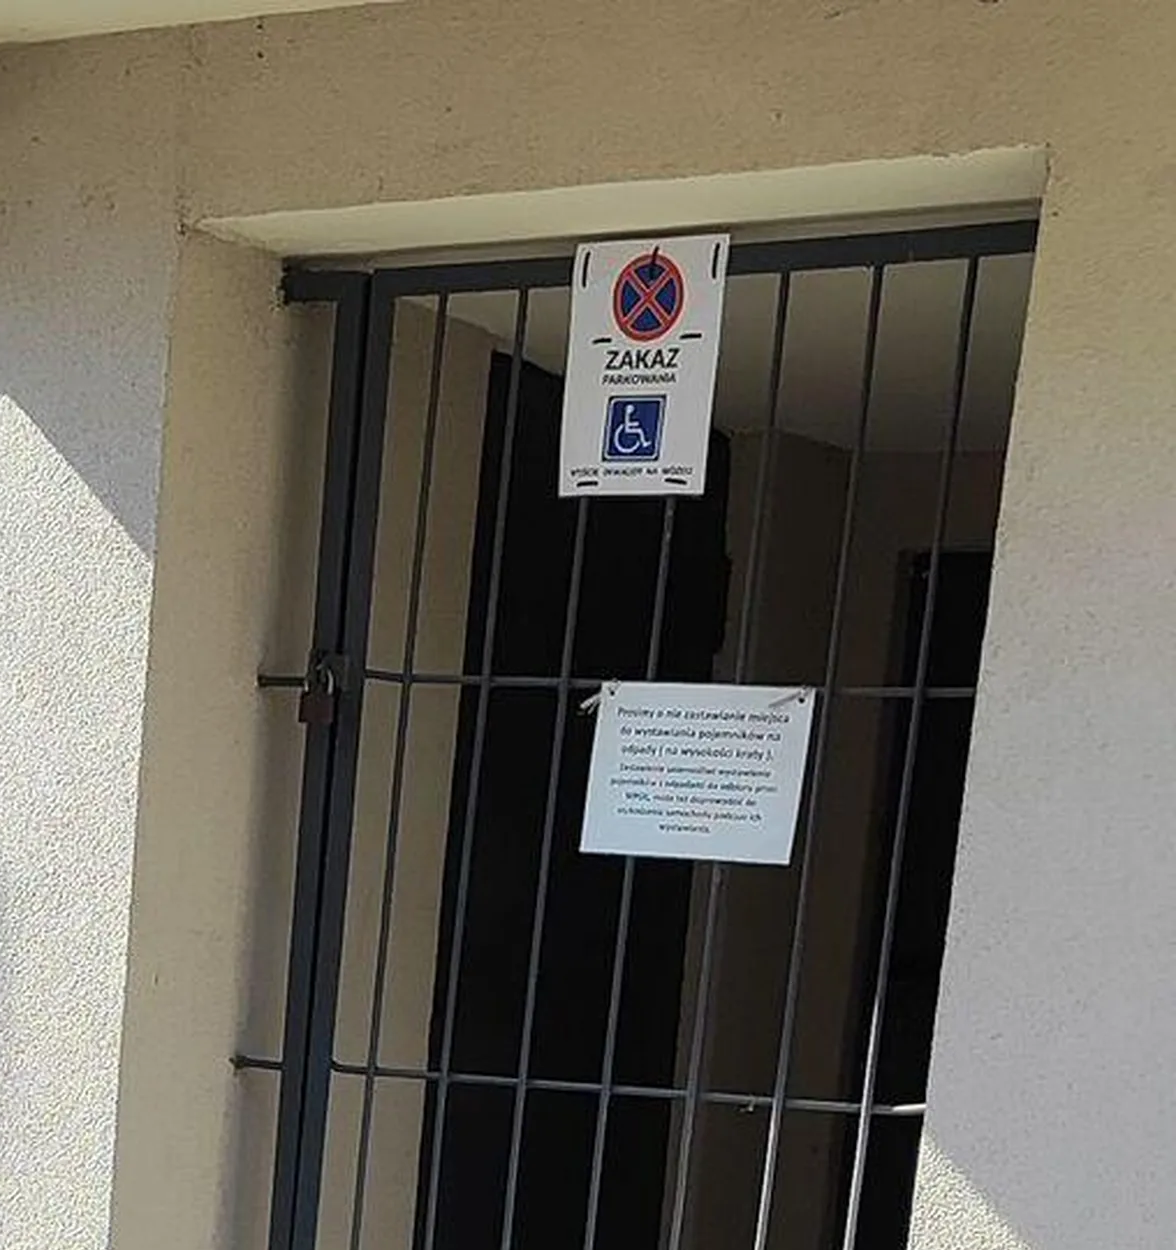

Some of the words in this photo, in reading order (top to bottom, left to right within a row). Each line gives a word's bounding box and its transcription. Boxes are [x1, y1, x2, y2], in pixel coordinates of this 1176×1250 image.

[605, 348, 680, 370] ZAKAZ
[601, 373, 677, 385] PARKOWANIA
[618, 708, 654, 722] Prosimy
[666, 709, 682, 719] nie
[685, 710, 746, 721] zastawianie
[748, 712, 791, 725] miejsca
[620, 726, 632, 736] do
[699, 728, 764, 742] pojemników
[766, 732, 782, 742] na
[622, 744, 656, 757] odpady
[664, 746, 679, 756] na
[681, 746, 734, 759] wysokości
[736, 749, 764, 761] kraty
